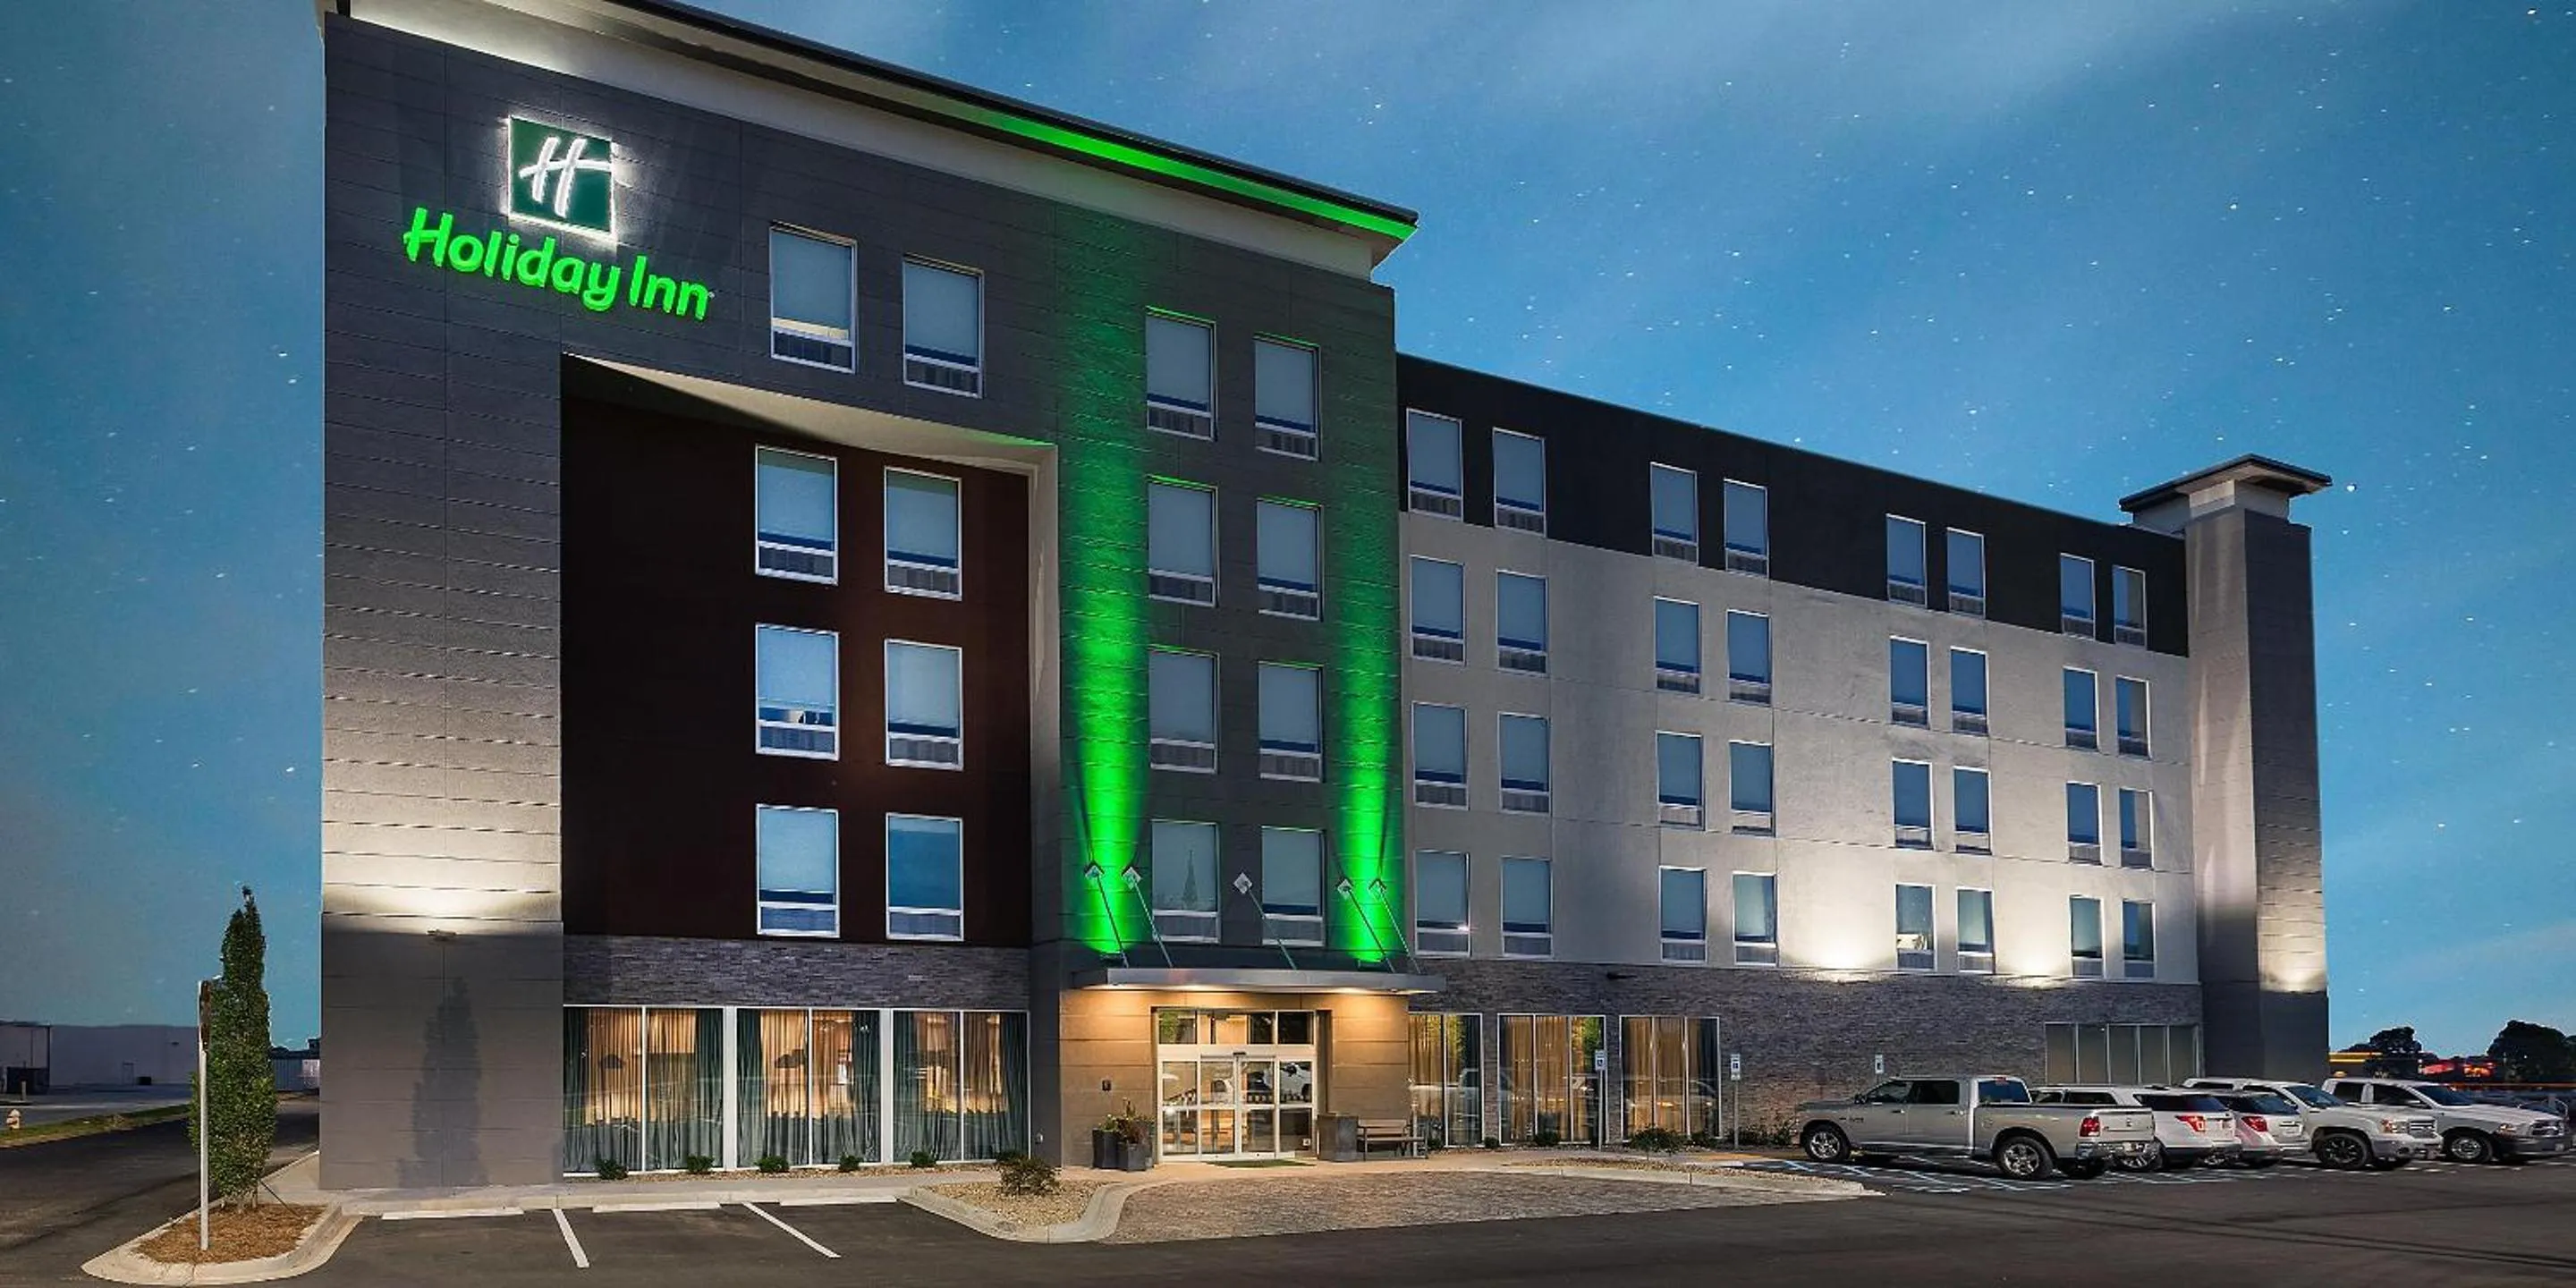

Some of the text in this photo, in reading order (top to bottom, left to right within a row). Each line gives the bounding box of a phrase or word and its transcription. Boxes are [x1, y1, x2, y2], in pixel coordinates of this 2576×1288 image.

[518, 136, 614, 218] H
[402, 207, 710, 320] Holiday Inn
